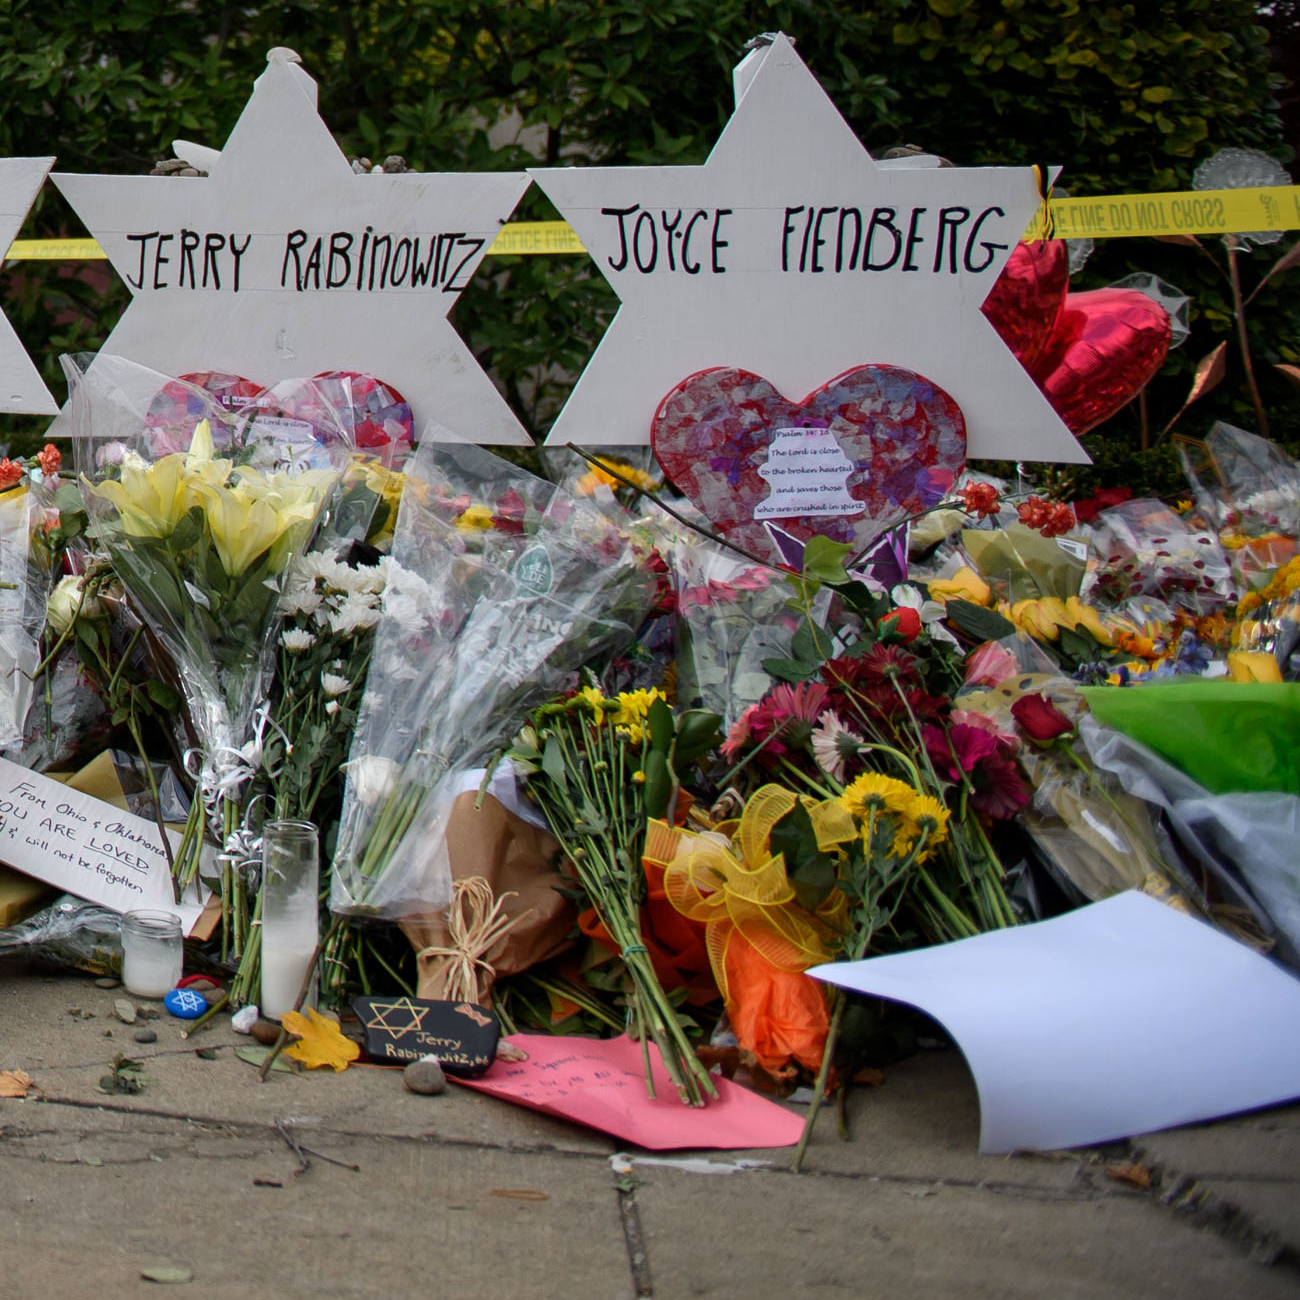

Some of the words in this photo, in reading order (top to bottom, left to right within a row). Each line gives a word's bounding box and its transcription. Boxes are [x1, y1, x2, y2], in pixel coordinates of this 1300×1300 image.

[601, 203, 733, 274] JOYCE
[782, 205, 1008, 274] FIENBERG
[126, 229, 252, 293] JERRY
[281, 228, 485, 293] RABINOWITZ
[771, 449, 787, 457] The
[788, 448, 809, 456] Lord
[818, 447, 840, 455] close
[772, 467, 786, 475] the
[787, 467, 818, 475] broken
[818, 465, 854, 474] hearted
[776, 486, 795, 494] and
[819, 484, 843, 492] those
[793, 503, 828, 512] crushed
[840, 502, 865, 512] spirit
[56, 802, 88, 823] Ohio
[39, 817, 78, 841] ARE
[89, 837, 150, 870] LOVED
[25, 836, 49, 851] will
[53, 849, 75, 863] not
[78, 856, 93, 869] be
[95, 863, 143, 894] forgotten
[416, 1031, 462, 1051] Jerry
